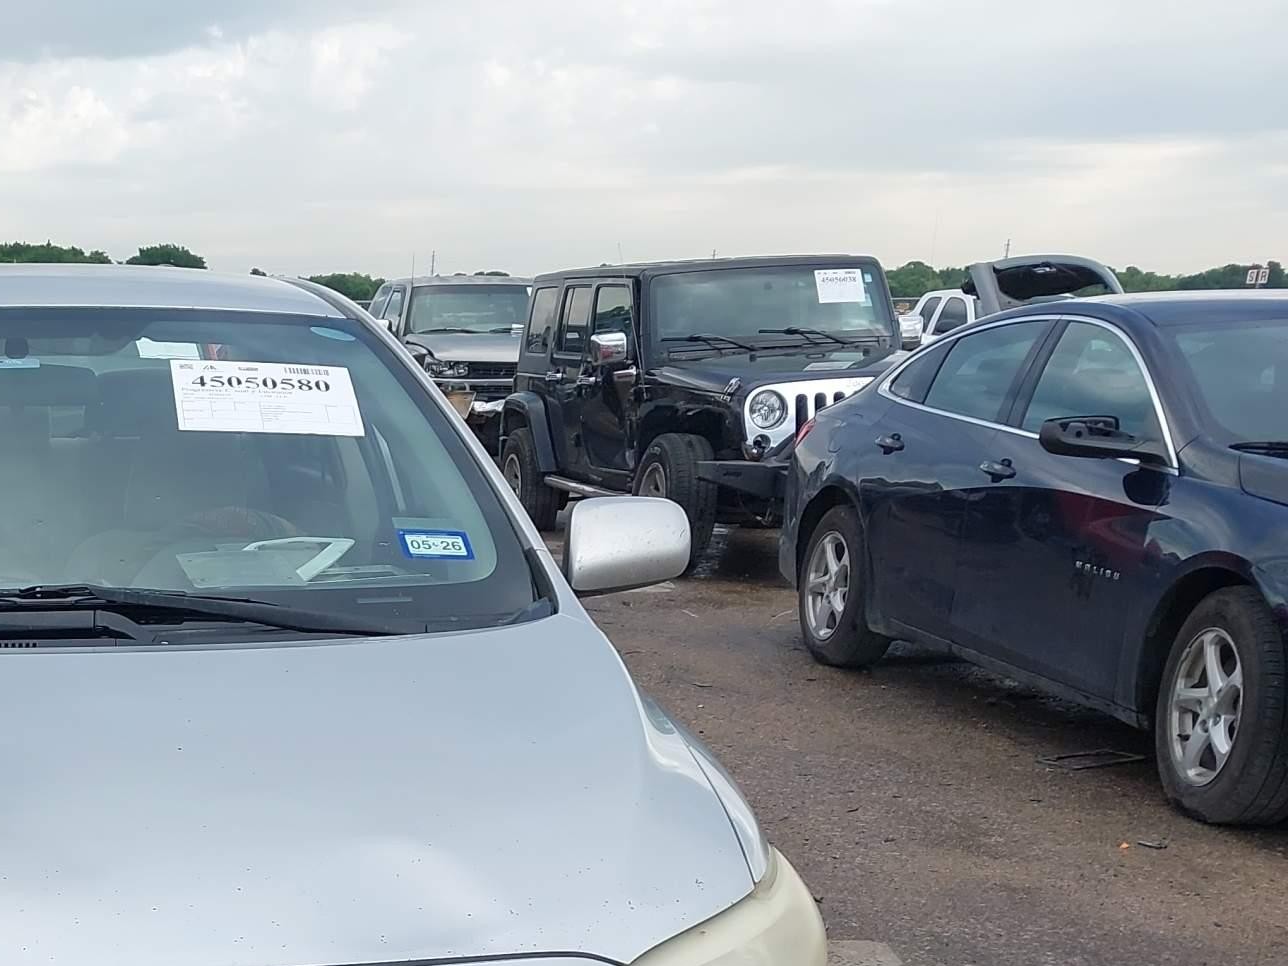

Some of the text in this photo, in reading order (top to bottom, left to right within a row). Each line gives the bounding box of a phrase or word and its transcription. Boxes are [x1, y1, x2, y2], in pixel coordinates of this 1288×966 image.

[191, 374, 331, 393] 45050580
[410, 539, 462, 551] 05 26
